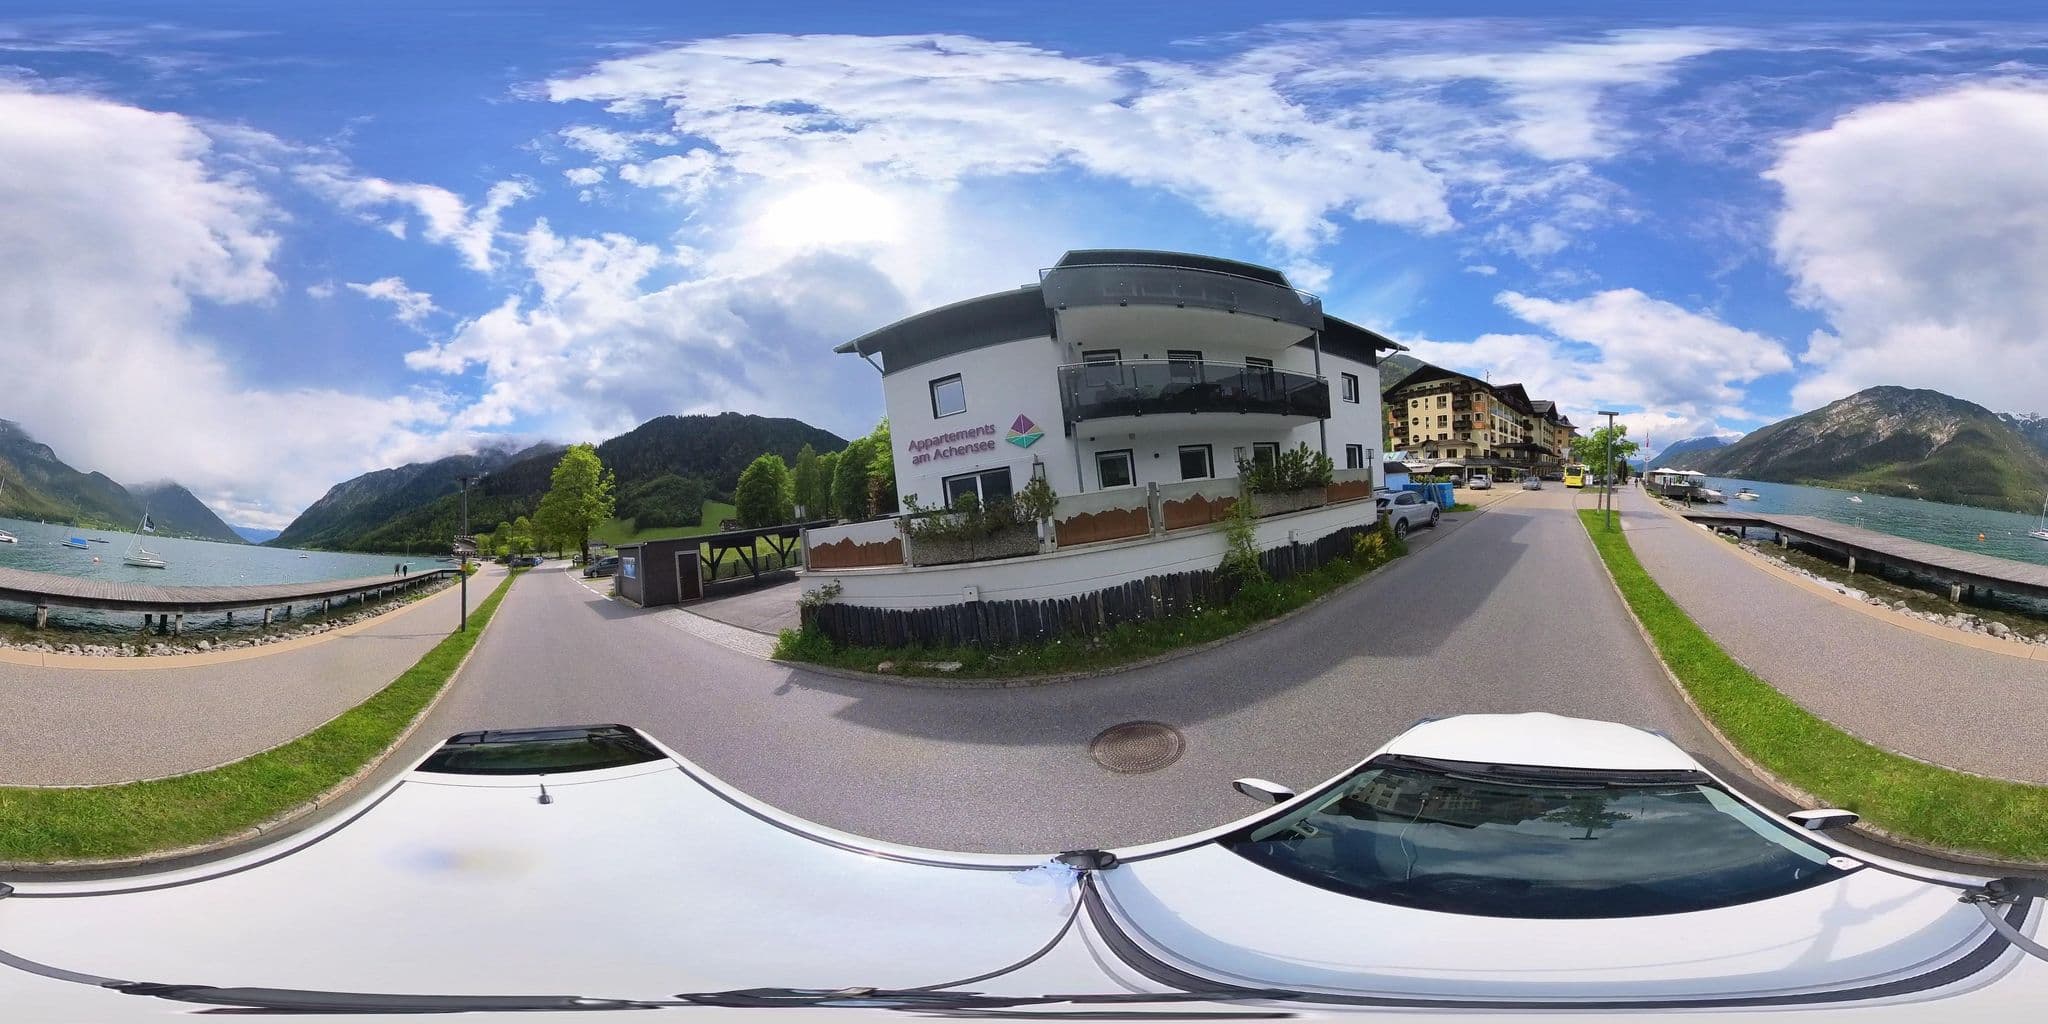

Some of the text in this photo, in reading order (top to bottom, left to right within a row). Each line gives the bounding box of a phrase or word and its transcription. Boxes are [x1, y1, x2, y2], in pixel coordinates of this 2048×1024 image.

[908, 423, 996, 452] Appartements
[912, 440, 996, 465] am Achensee
